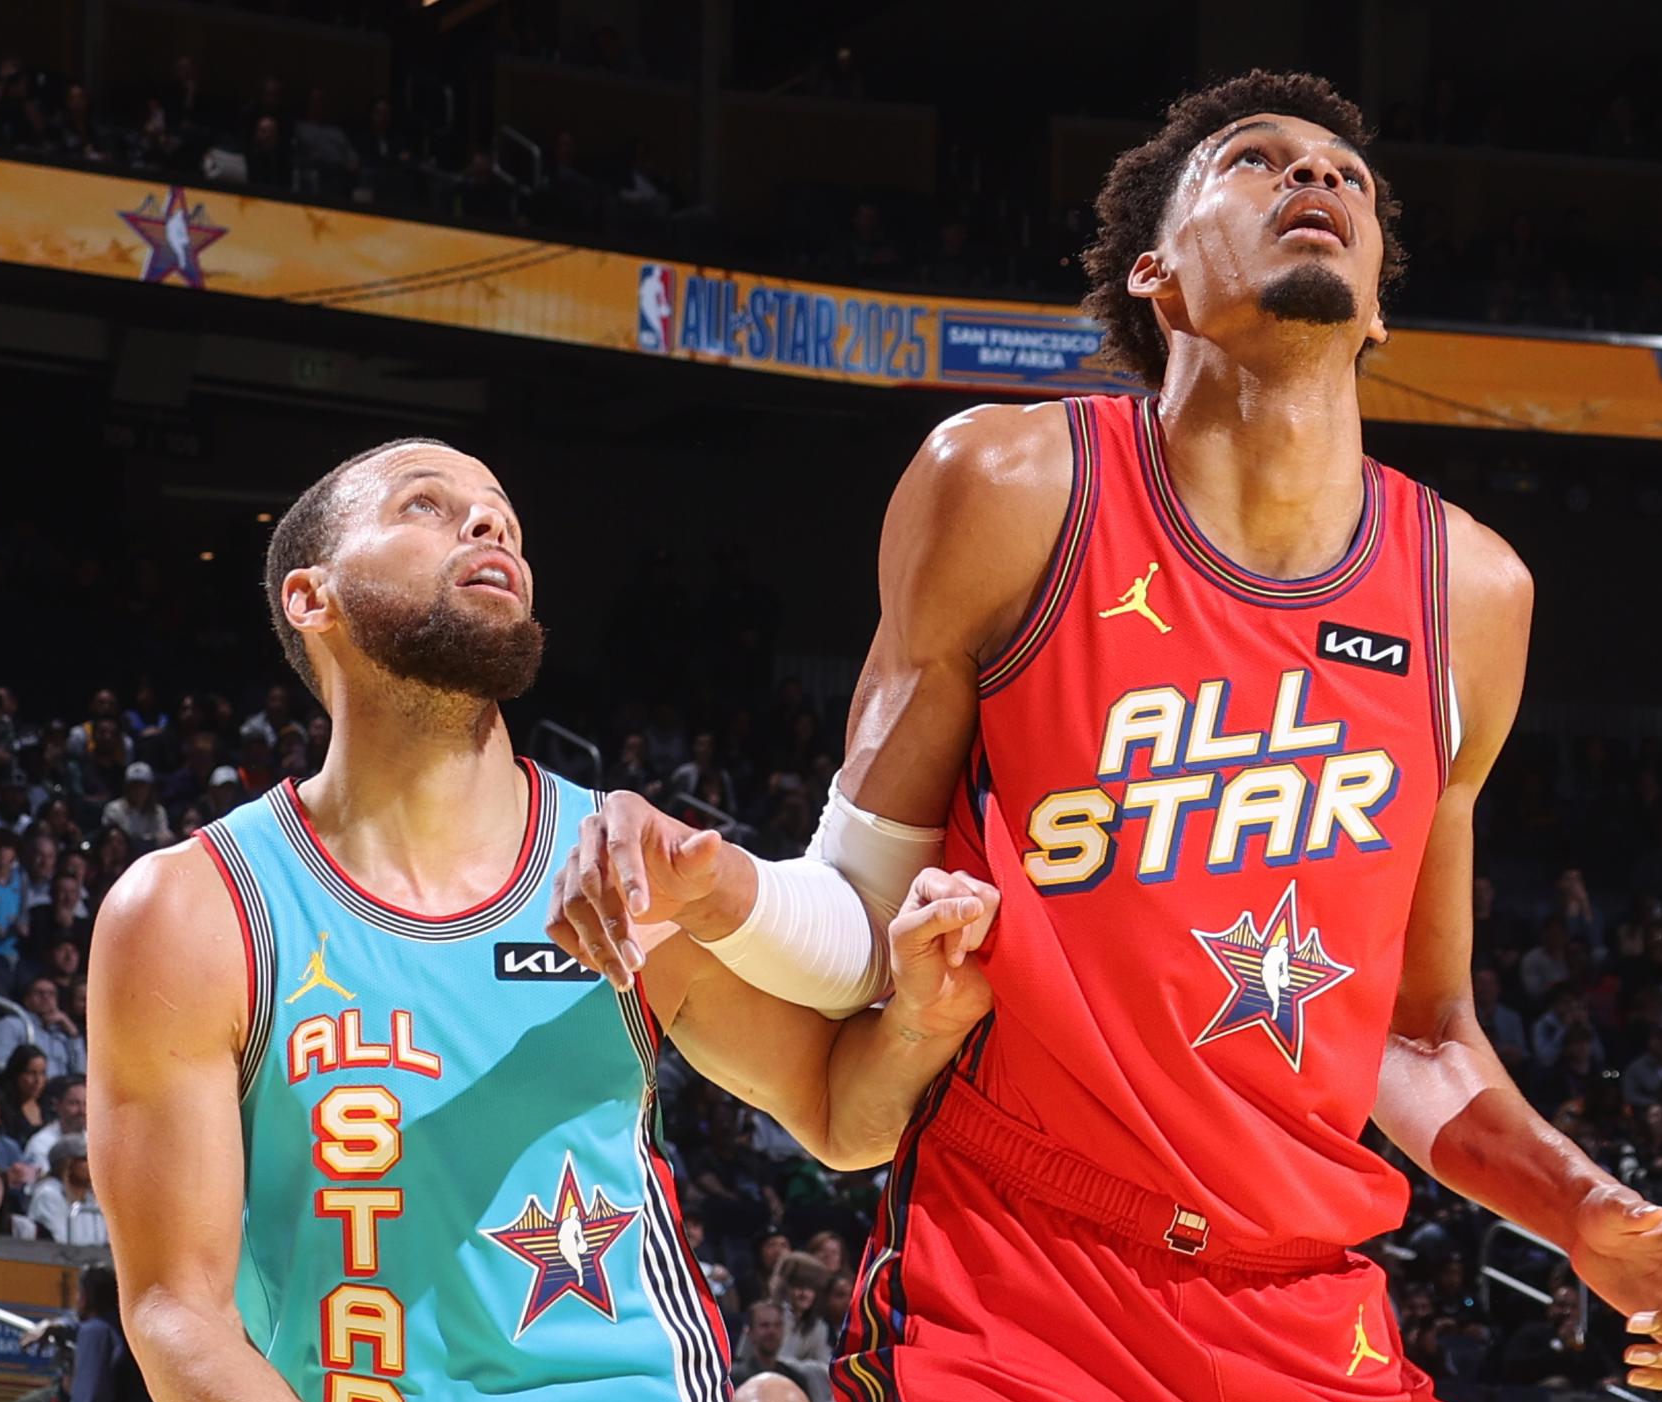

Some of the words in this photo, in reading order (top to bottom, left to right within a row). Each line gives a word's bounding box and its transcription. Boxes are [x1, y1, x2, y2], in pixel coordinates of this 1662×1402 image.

[842, 299, 928, 379] 2025
[948, 327, 985, 345] SAN
[989, 329, 1100, 354] FRANCISCO
[978, 347, 1015, 365] BAY
[1015, 350, 1067, 369] AREA
[1325, 631, 1403, 668] KIA
[1096, 668, 1346, 782] ALL
[1024, 749, 1400, 897] STAR
[287, 1009, 441, 1085] ALL
